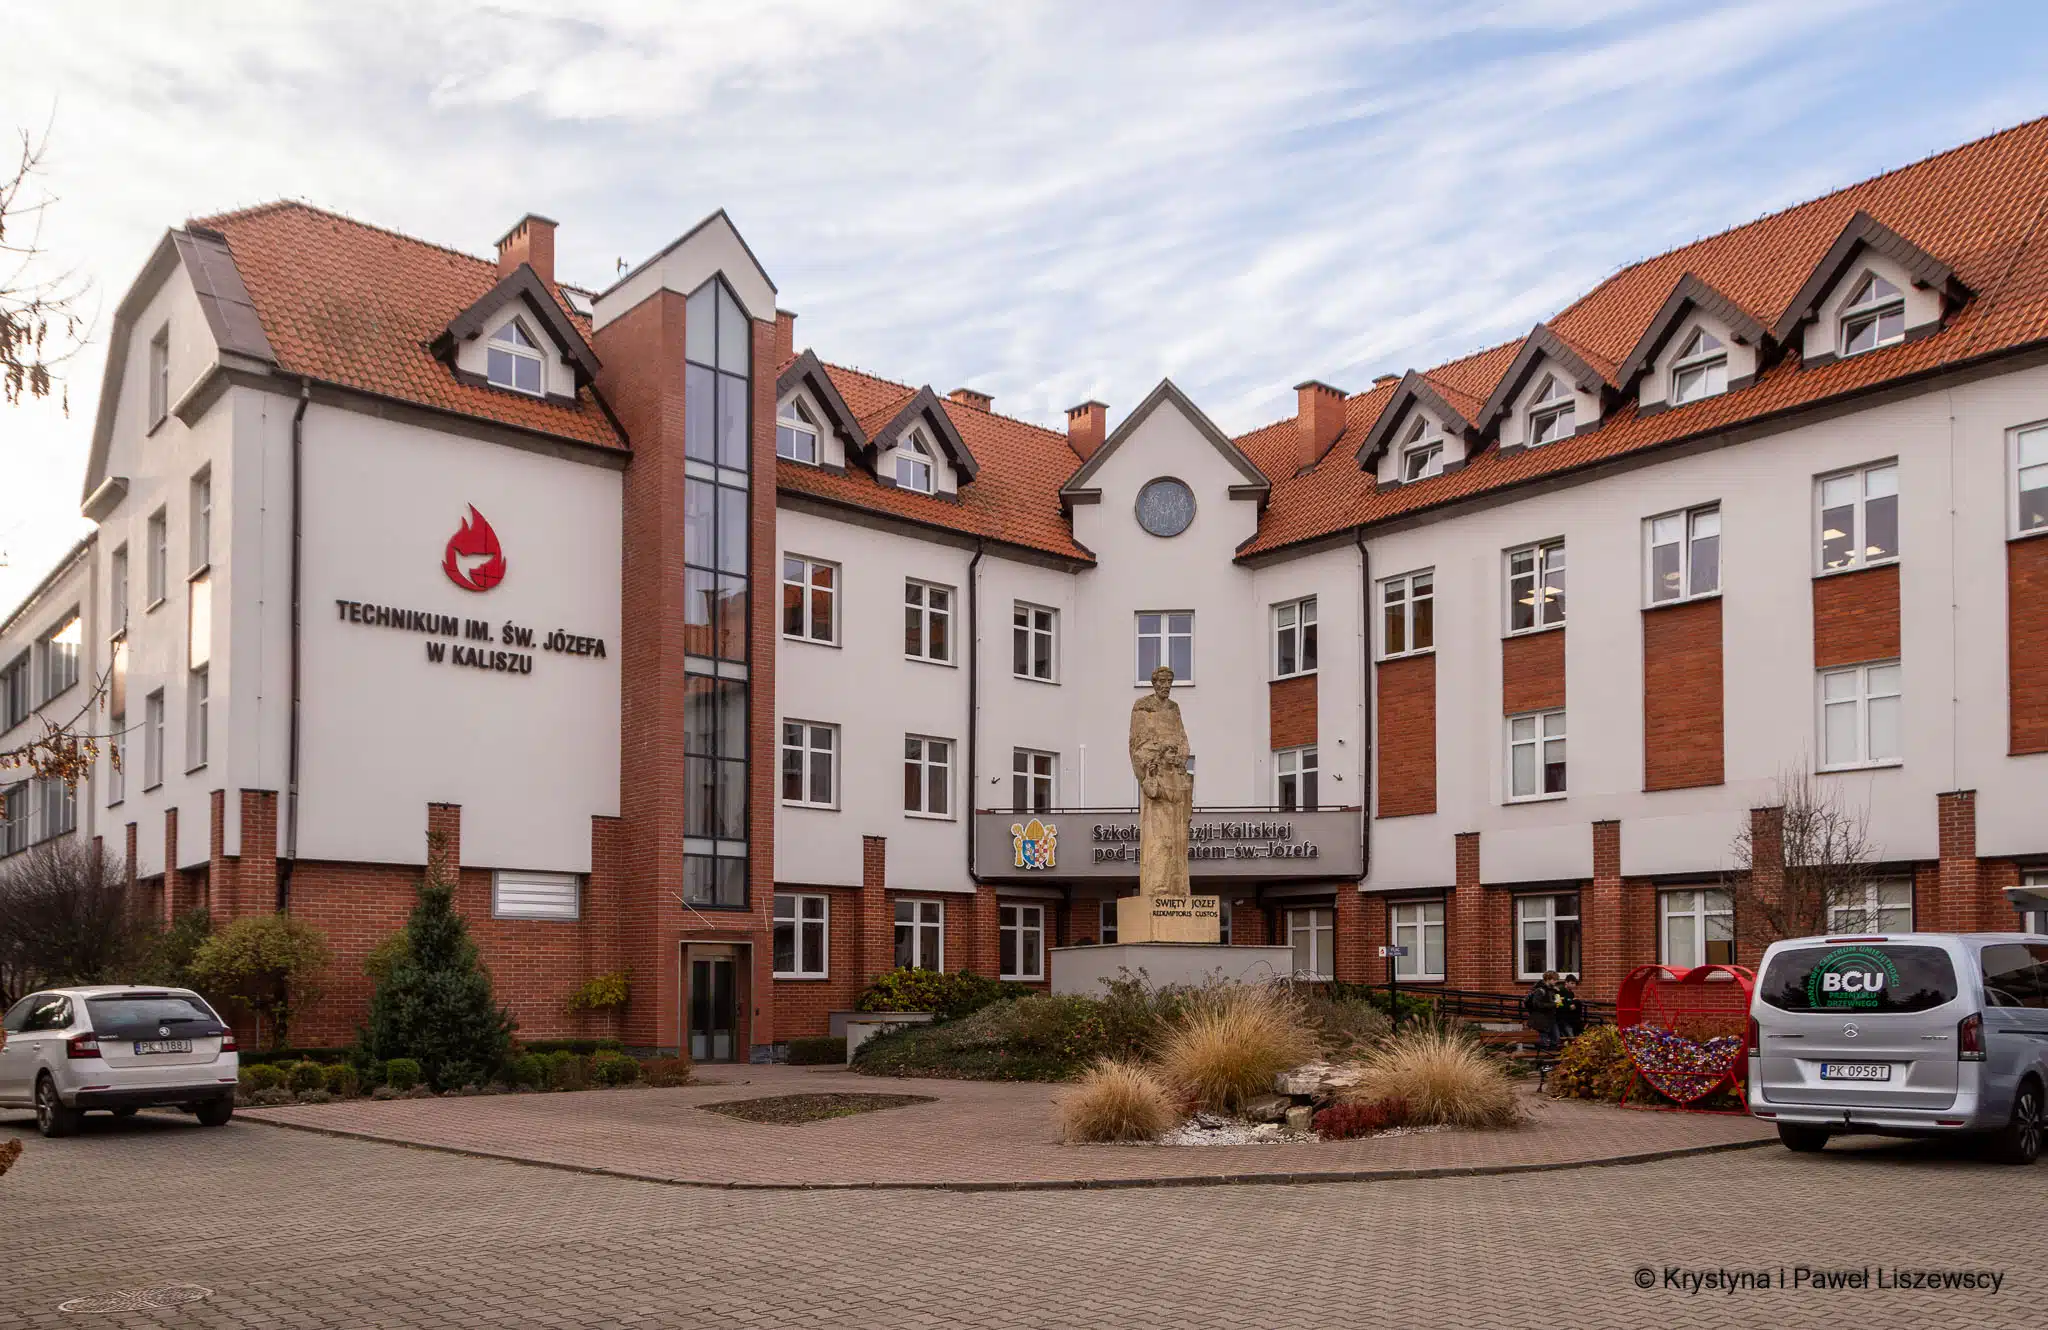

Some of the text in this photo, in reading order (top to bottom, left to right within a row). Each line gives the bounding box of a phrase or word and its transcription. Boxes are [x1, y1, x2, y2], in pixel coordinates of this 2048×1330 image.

[335, 599, 607, 658] TECHNIKUM IM. ŚW. JÓZEFA
[426, 641, 533, 675] W KALISZU
[1220, 822, 1291, 841] Kaliskiej
[1092, 843, 1127, 864] pod
[1234, 843, 1259, 858] św.
[1266, 840, 1318, 858] Józefa
[1194, 910, 1218, 918] CUSTOS
[1819, 946, 1857, 967] CENTRUM
[1822, 970, 1884, 992] BCU
[143, 1042, 156, 1052] PK
[1829, 1065, 1886, 1077] PK 0958T
